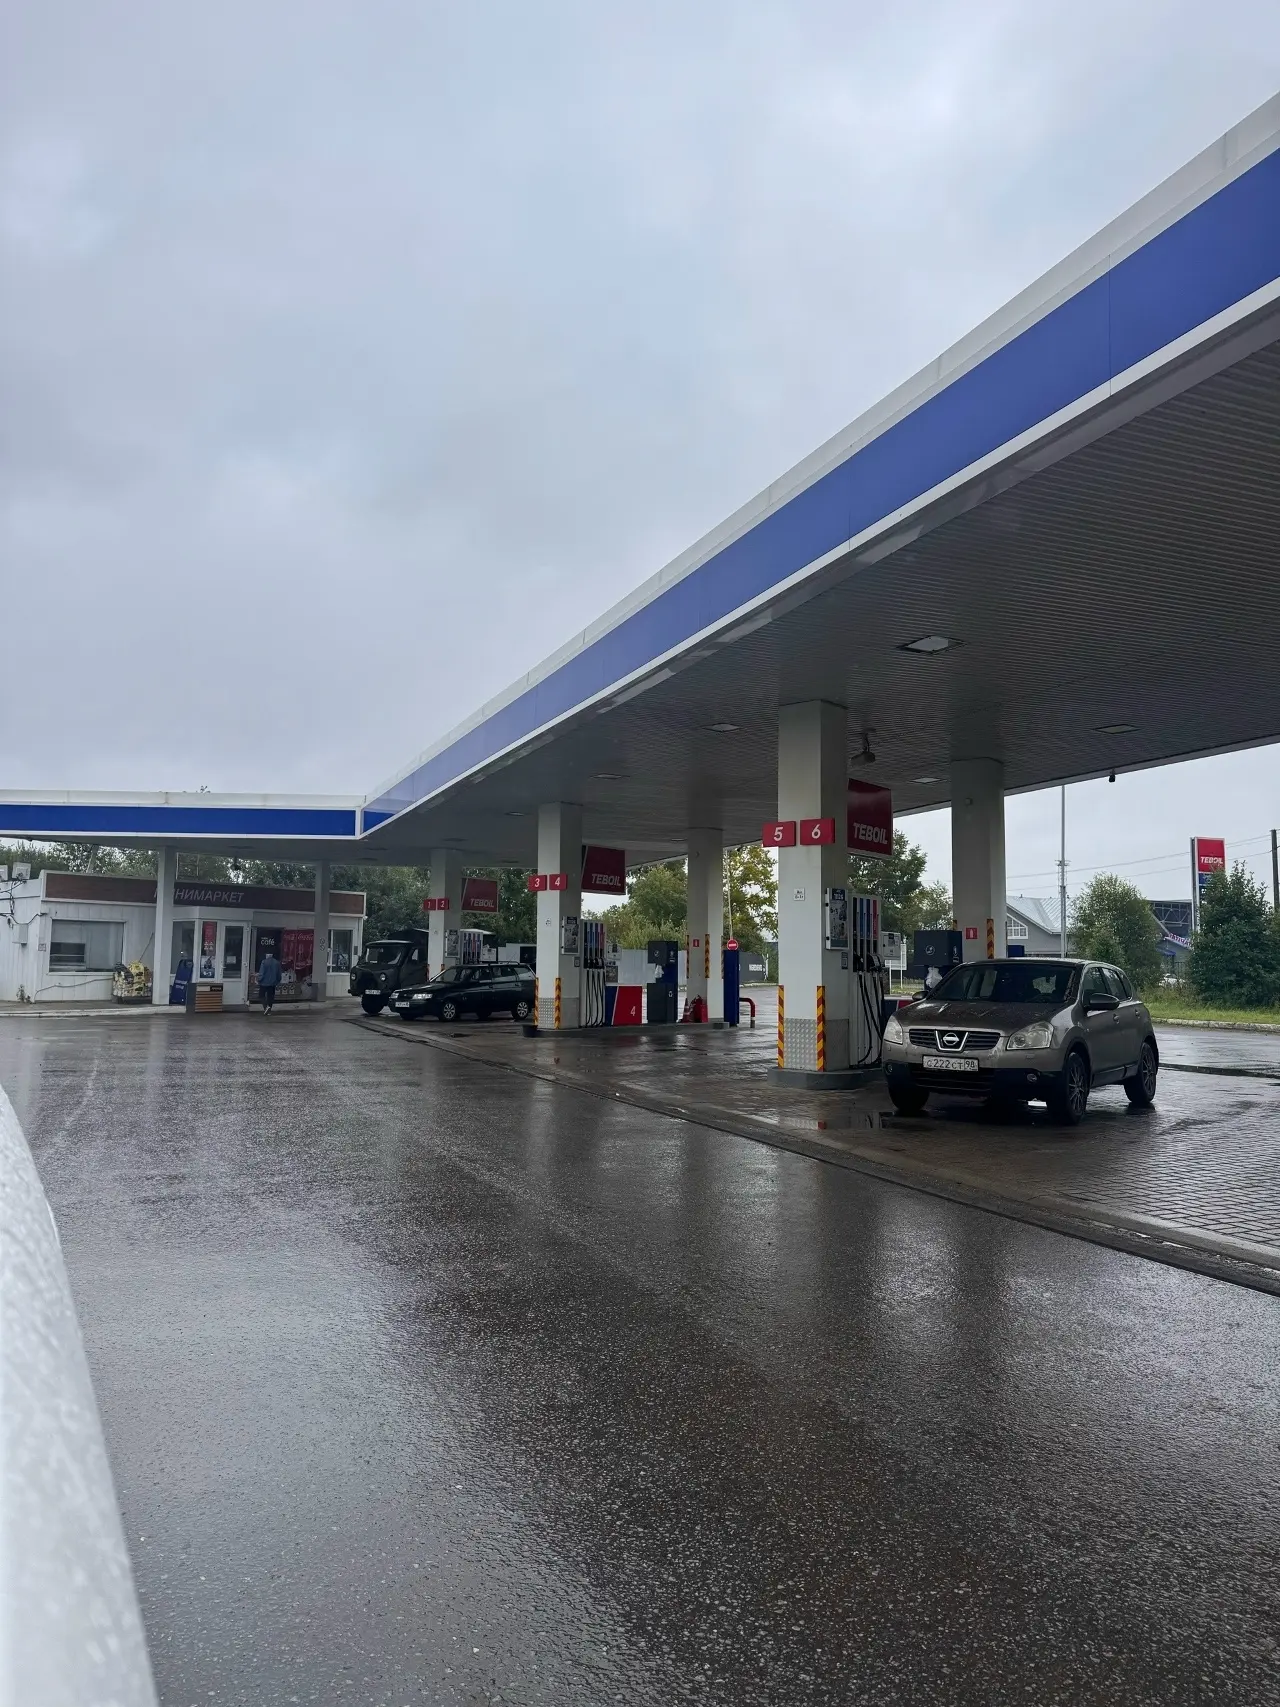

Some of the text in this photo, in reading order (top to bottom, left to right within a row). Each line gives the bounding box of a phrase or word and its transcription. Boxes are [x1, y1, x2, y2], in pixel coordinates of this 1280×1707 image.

[774, 826, 783, 842] 5
[812, 824, 821, 839] 6
[853, 821, 889, 845] TEBOIL
[1200, 856, 1223, 864] TEBOIL
[534, 878, 540, 888] 3
[554, 877, 561, 886] 4
[591, 873, 622, 886] TEBOIL
[154, 888, 245, 903] НИМАРКЕТ
[470, 898, 495, 908] TEBOIL
[630, 1005, 636, 1016] 4
